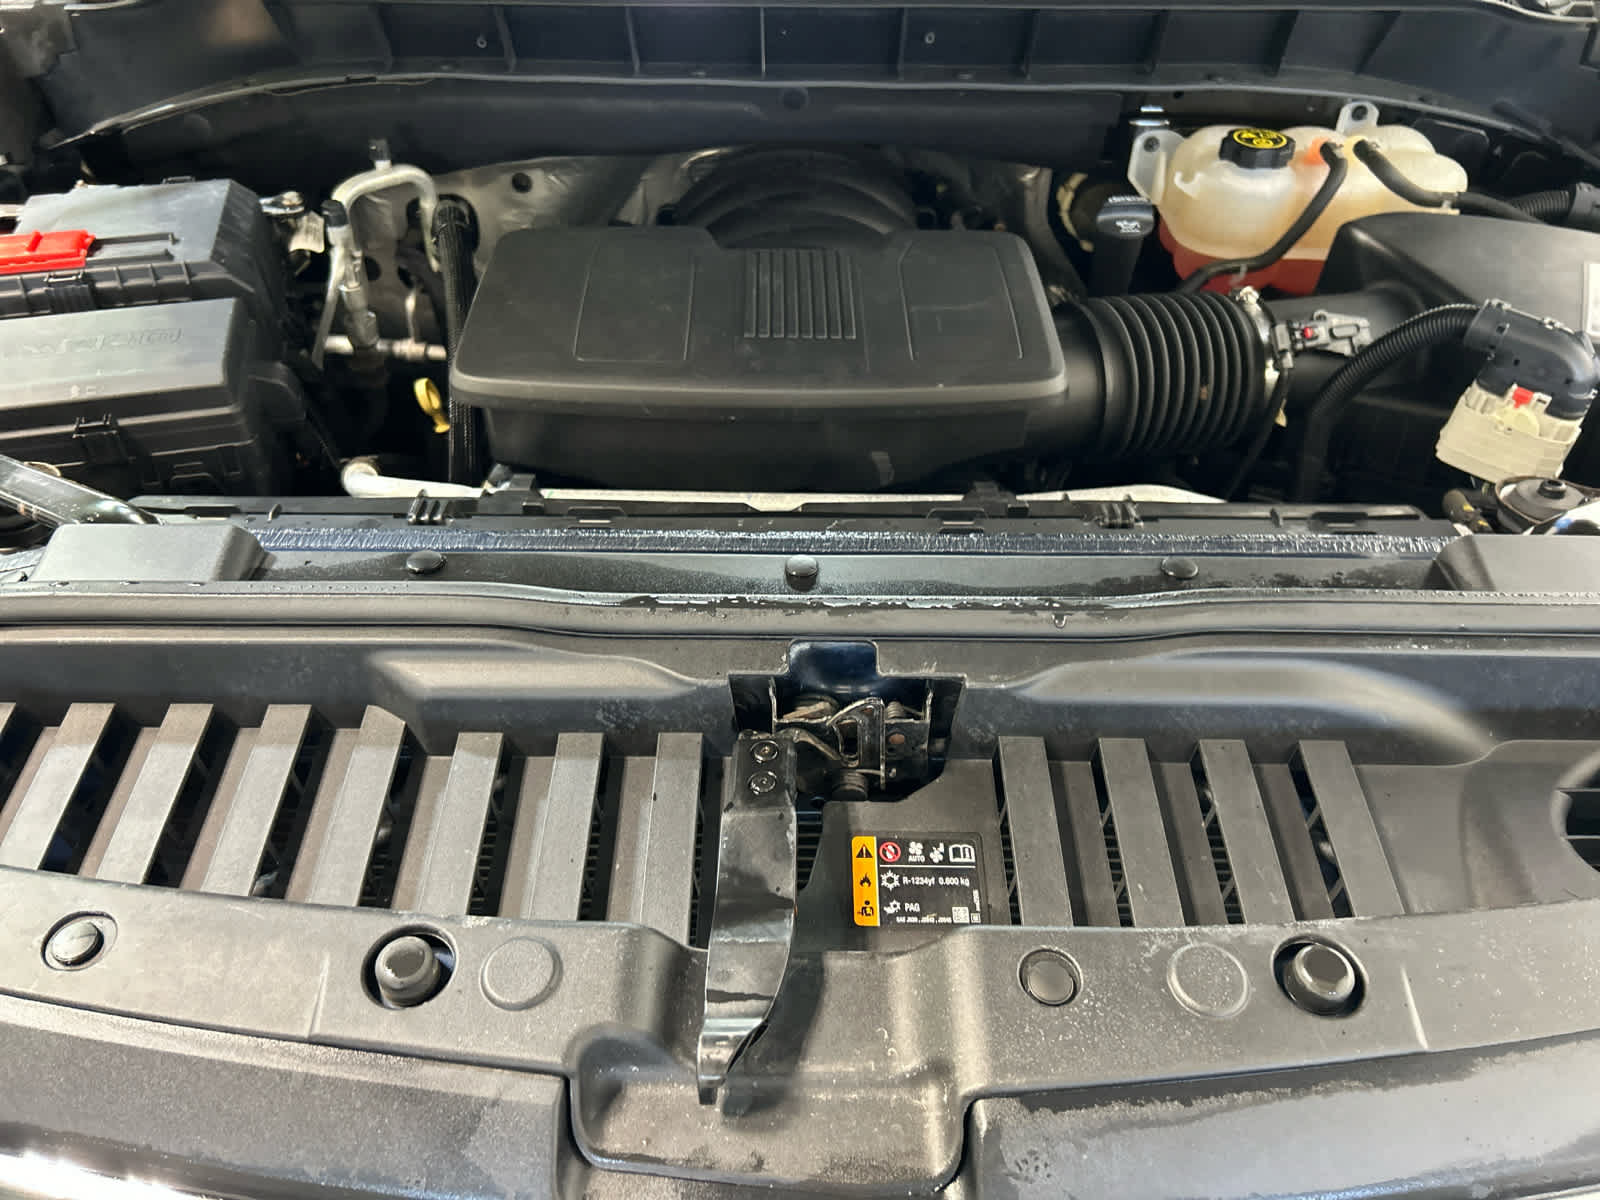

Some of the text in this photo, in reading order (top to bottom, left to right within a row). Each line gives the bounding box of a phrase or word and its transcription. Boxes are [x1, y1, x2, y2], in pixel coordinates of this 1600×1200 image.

[908, 855, 926, 863] AUTO
[902, 876, 935, 887] R-1234yf
[960, 876, 970, 888] kg
[904, 902, 920, 913] PAG
